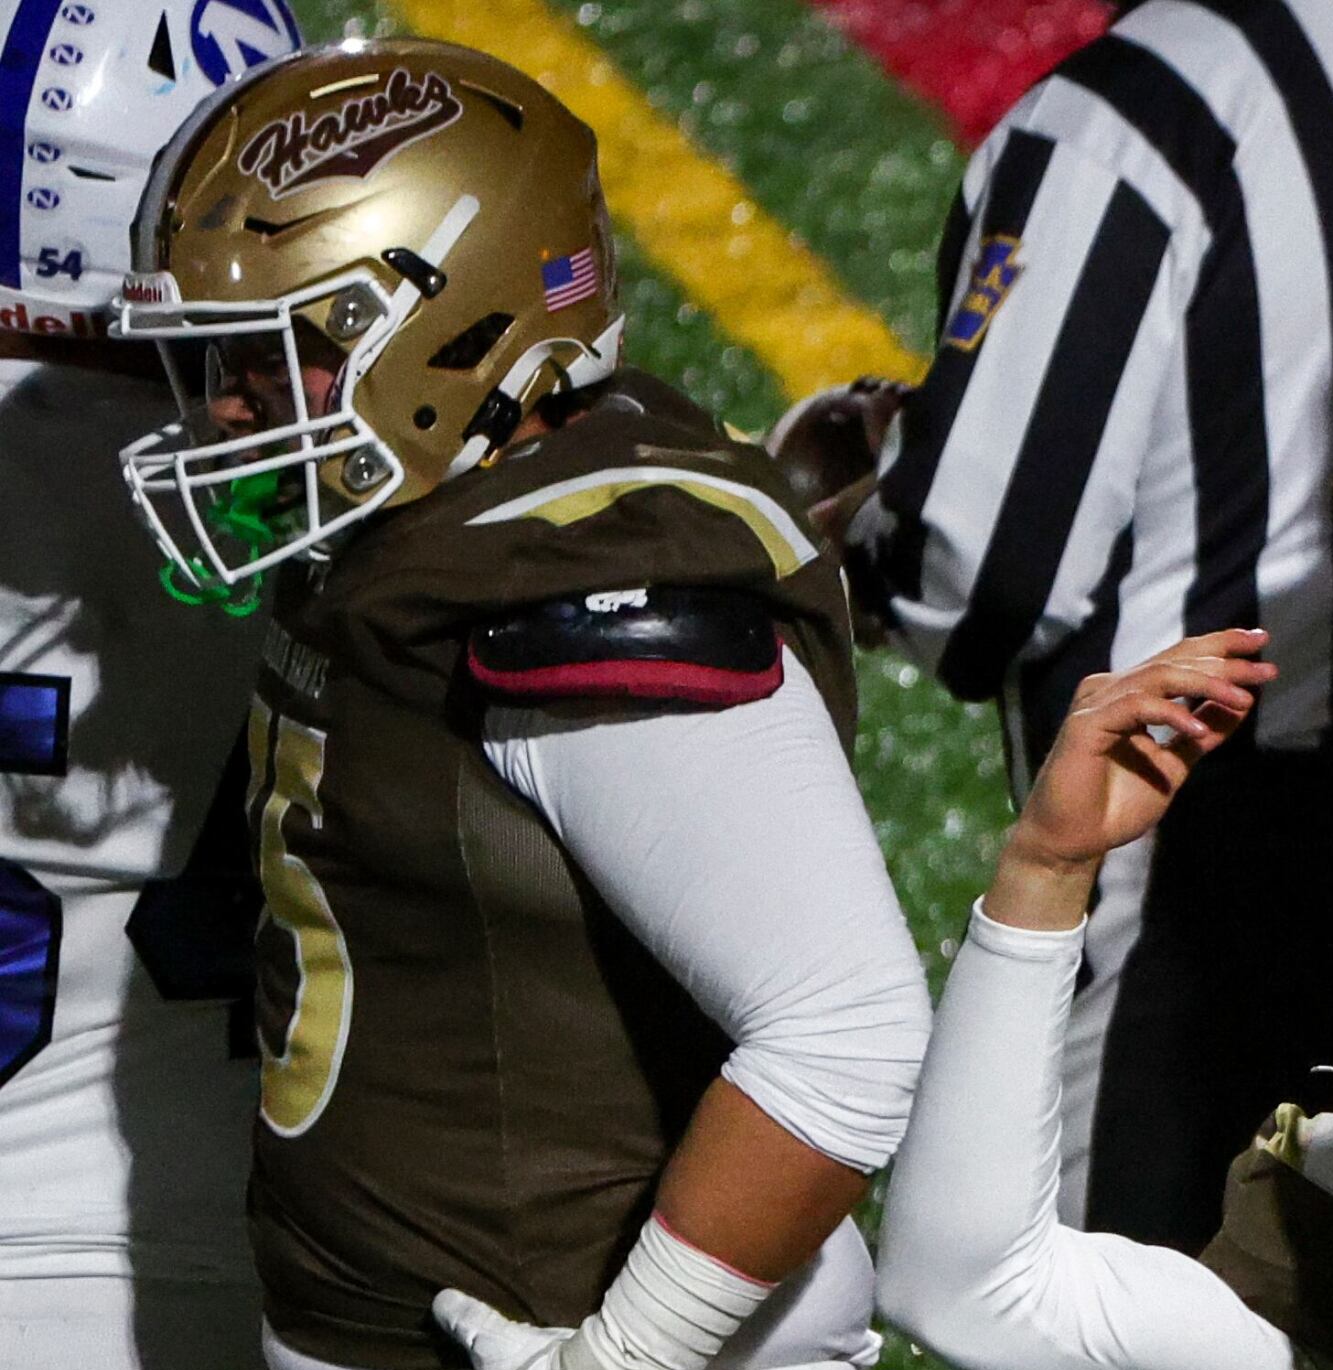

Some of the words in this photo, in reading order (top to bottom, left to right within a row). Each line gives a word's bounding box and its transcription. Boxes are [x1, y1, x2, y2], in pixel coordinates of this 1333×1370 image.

[238, 69, 460, 190] Hawks
[36, 247, 83, 281] 54
[0, 303, 105, 337] dell
